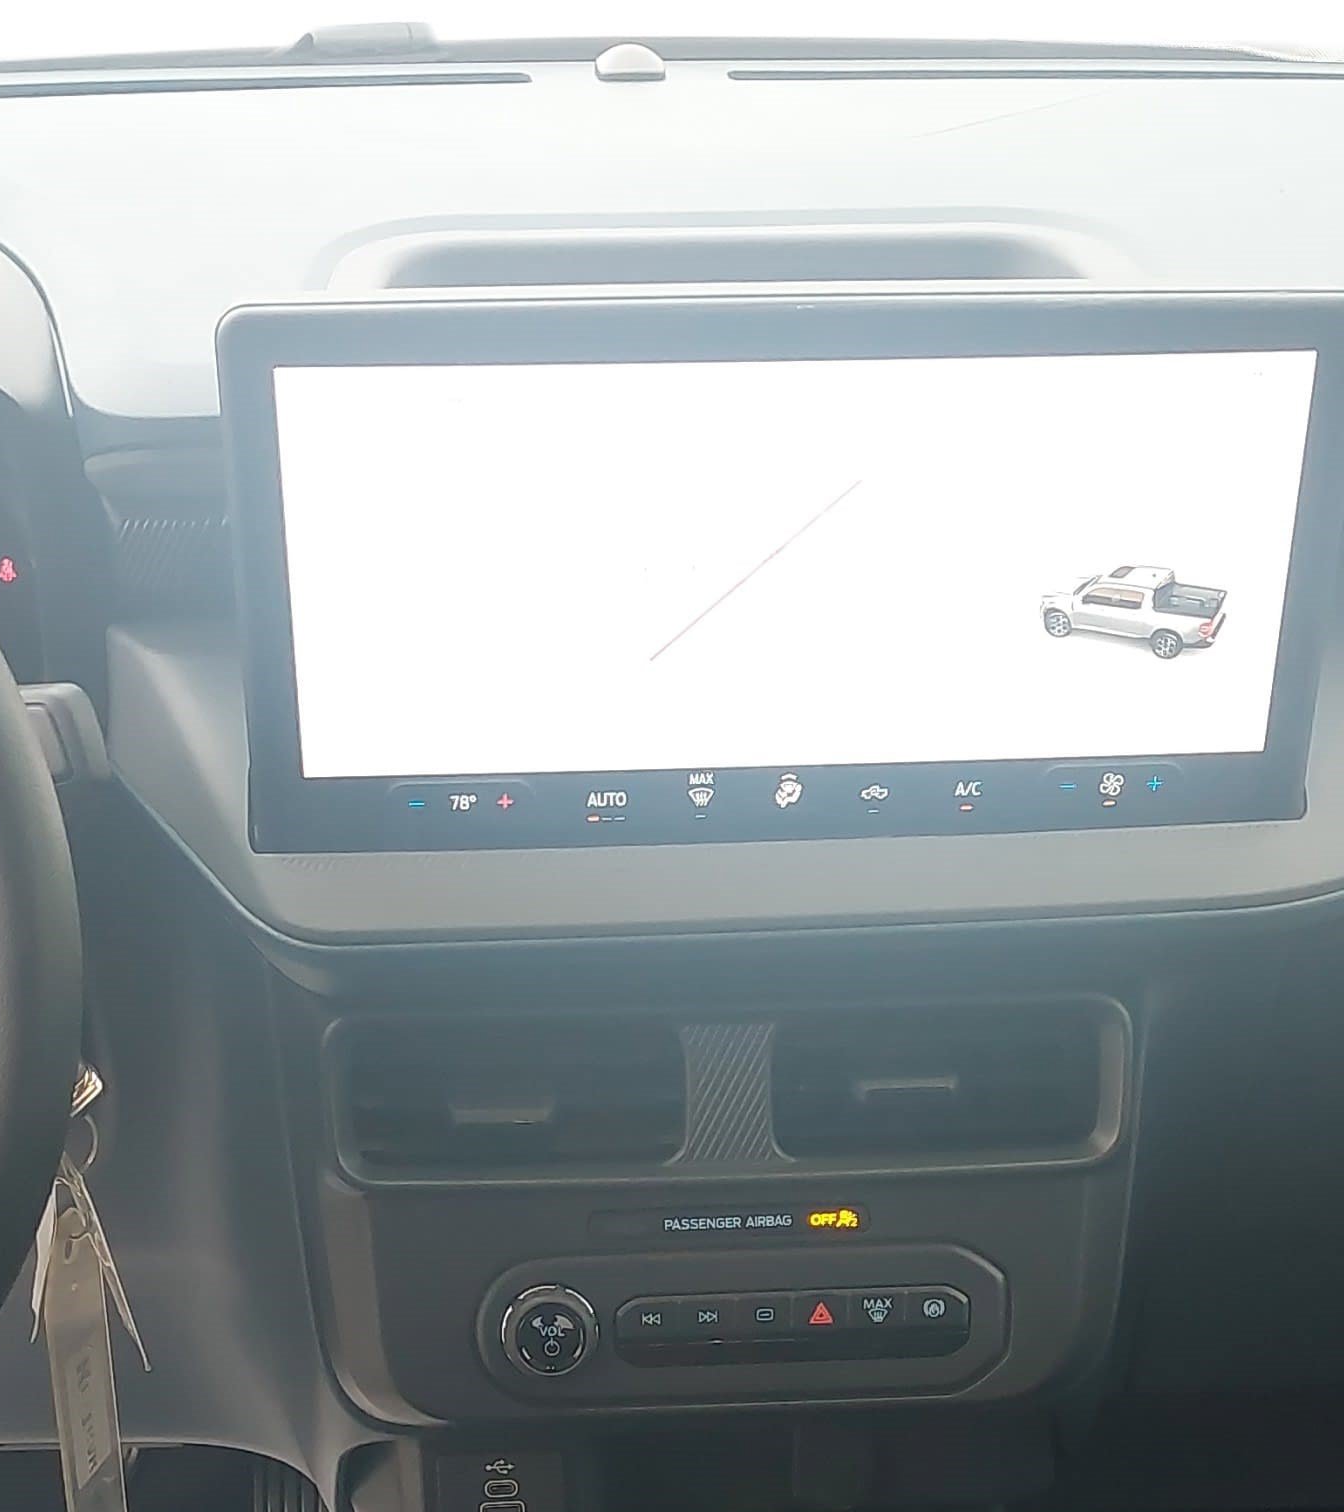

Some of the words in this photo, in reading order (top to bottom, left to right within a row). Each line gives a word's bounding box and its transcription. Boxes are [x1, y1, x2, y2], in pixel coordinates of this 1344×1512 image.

[690, 772, 714, 786] MAX
[955, 781, 983, 797] A/C
[586, 791, 627, 808] AUTO
[664, 1216, 742, 1231] PASSENGER
[745, 1214, 792, 1228] AIRBAG
[810, 1212, 837, 1227] OFF
[863, 1297, 893, 1310] MAX
[539, 1325, 566, 1337] VOL
